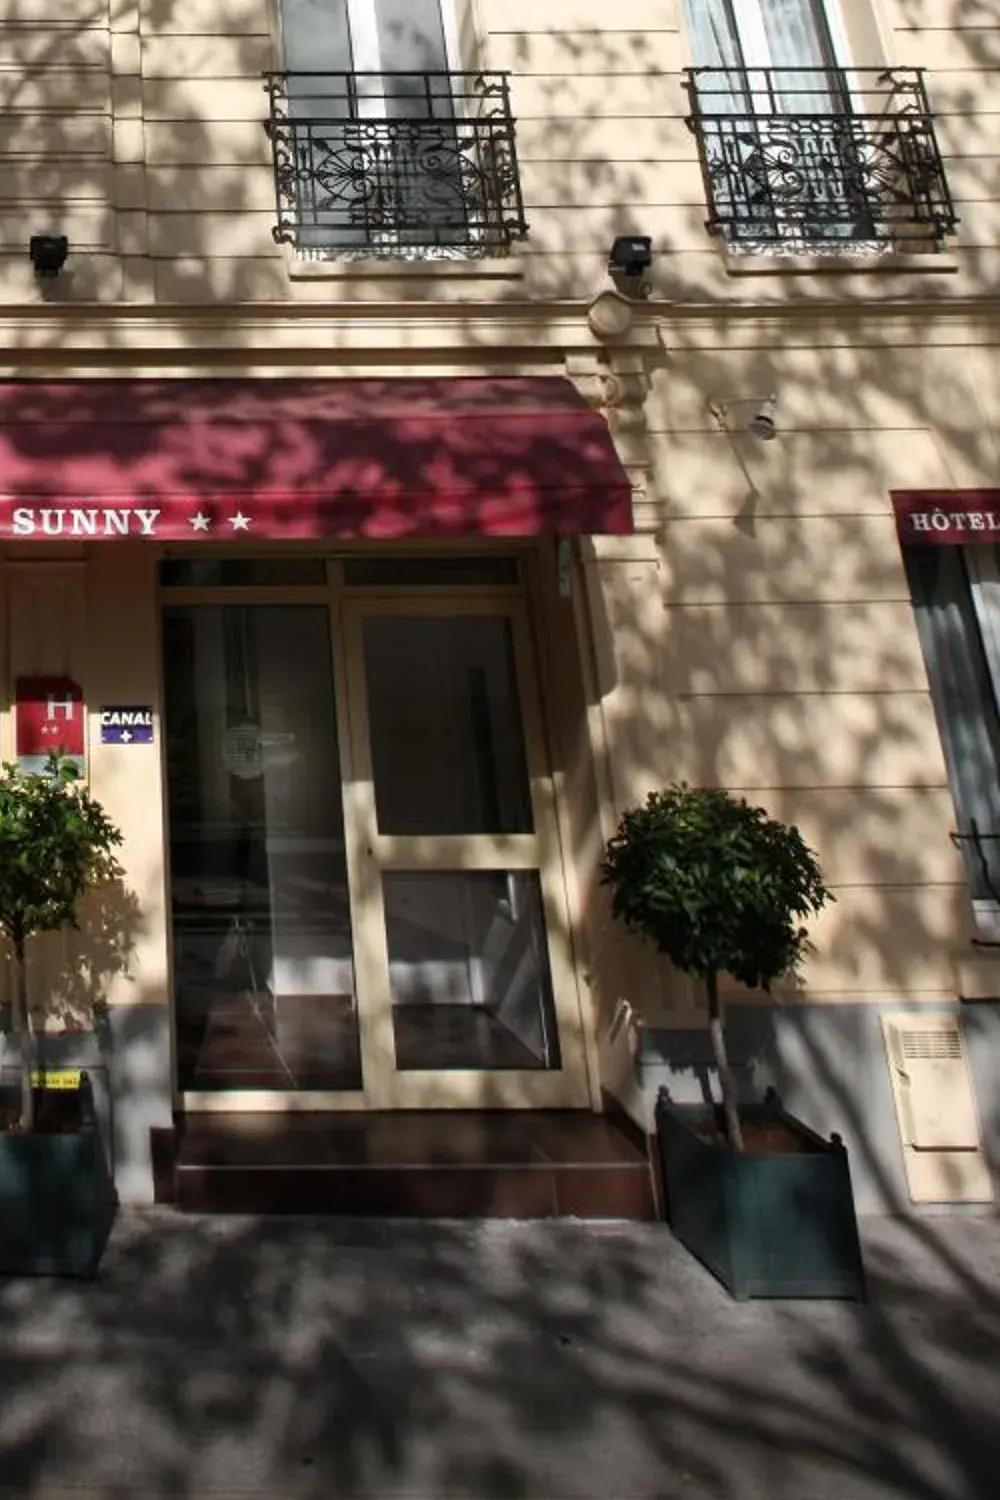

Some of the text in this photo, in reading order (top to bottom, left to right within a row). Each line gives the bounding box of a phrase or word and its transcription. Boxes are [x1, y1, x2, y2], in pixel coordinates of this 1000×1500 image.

[12, 508, 161, 536] SUNNY
[909, 507, 1000, 531] HÔTEL
[47, 693, 73, 720] H
[101, 711, 152, 725] CANAL
